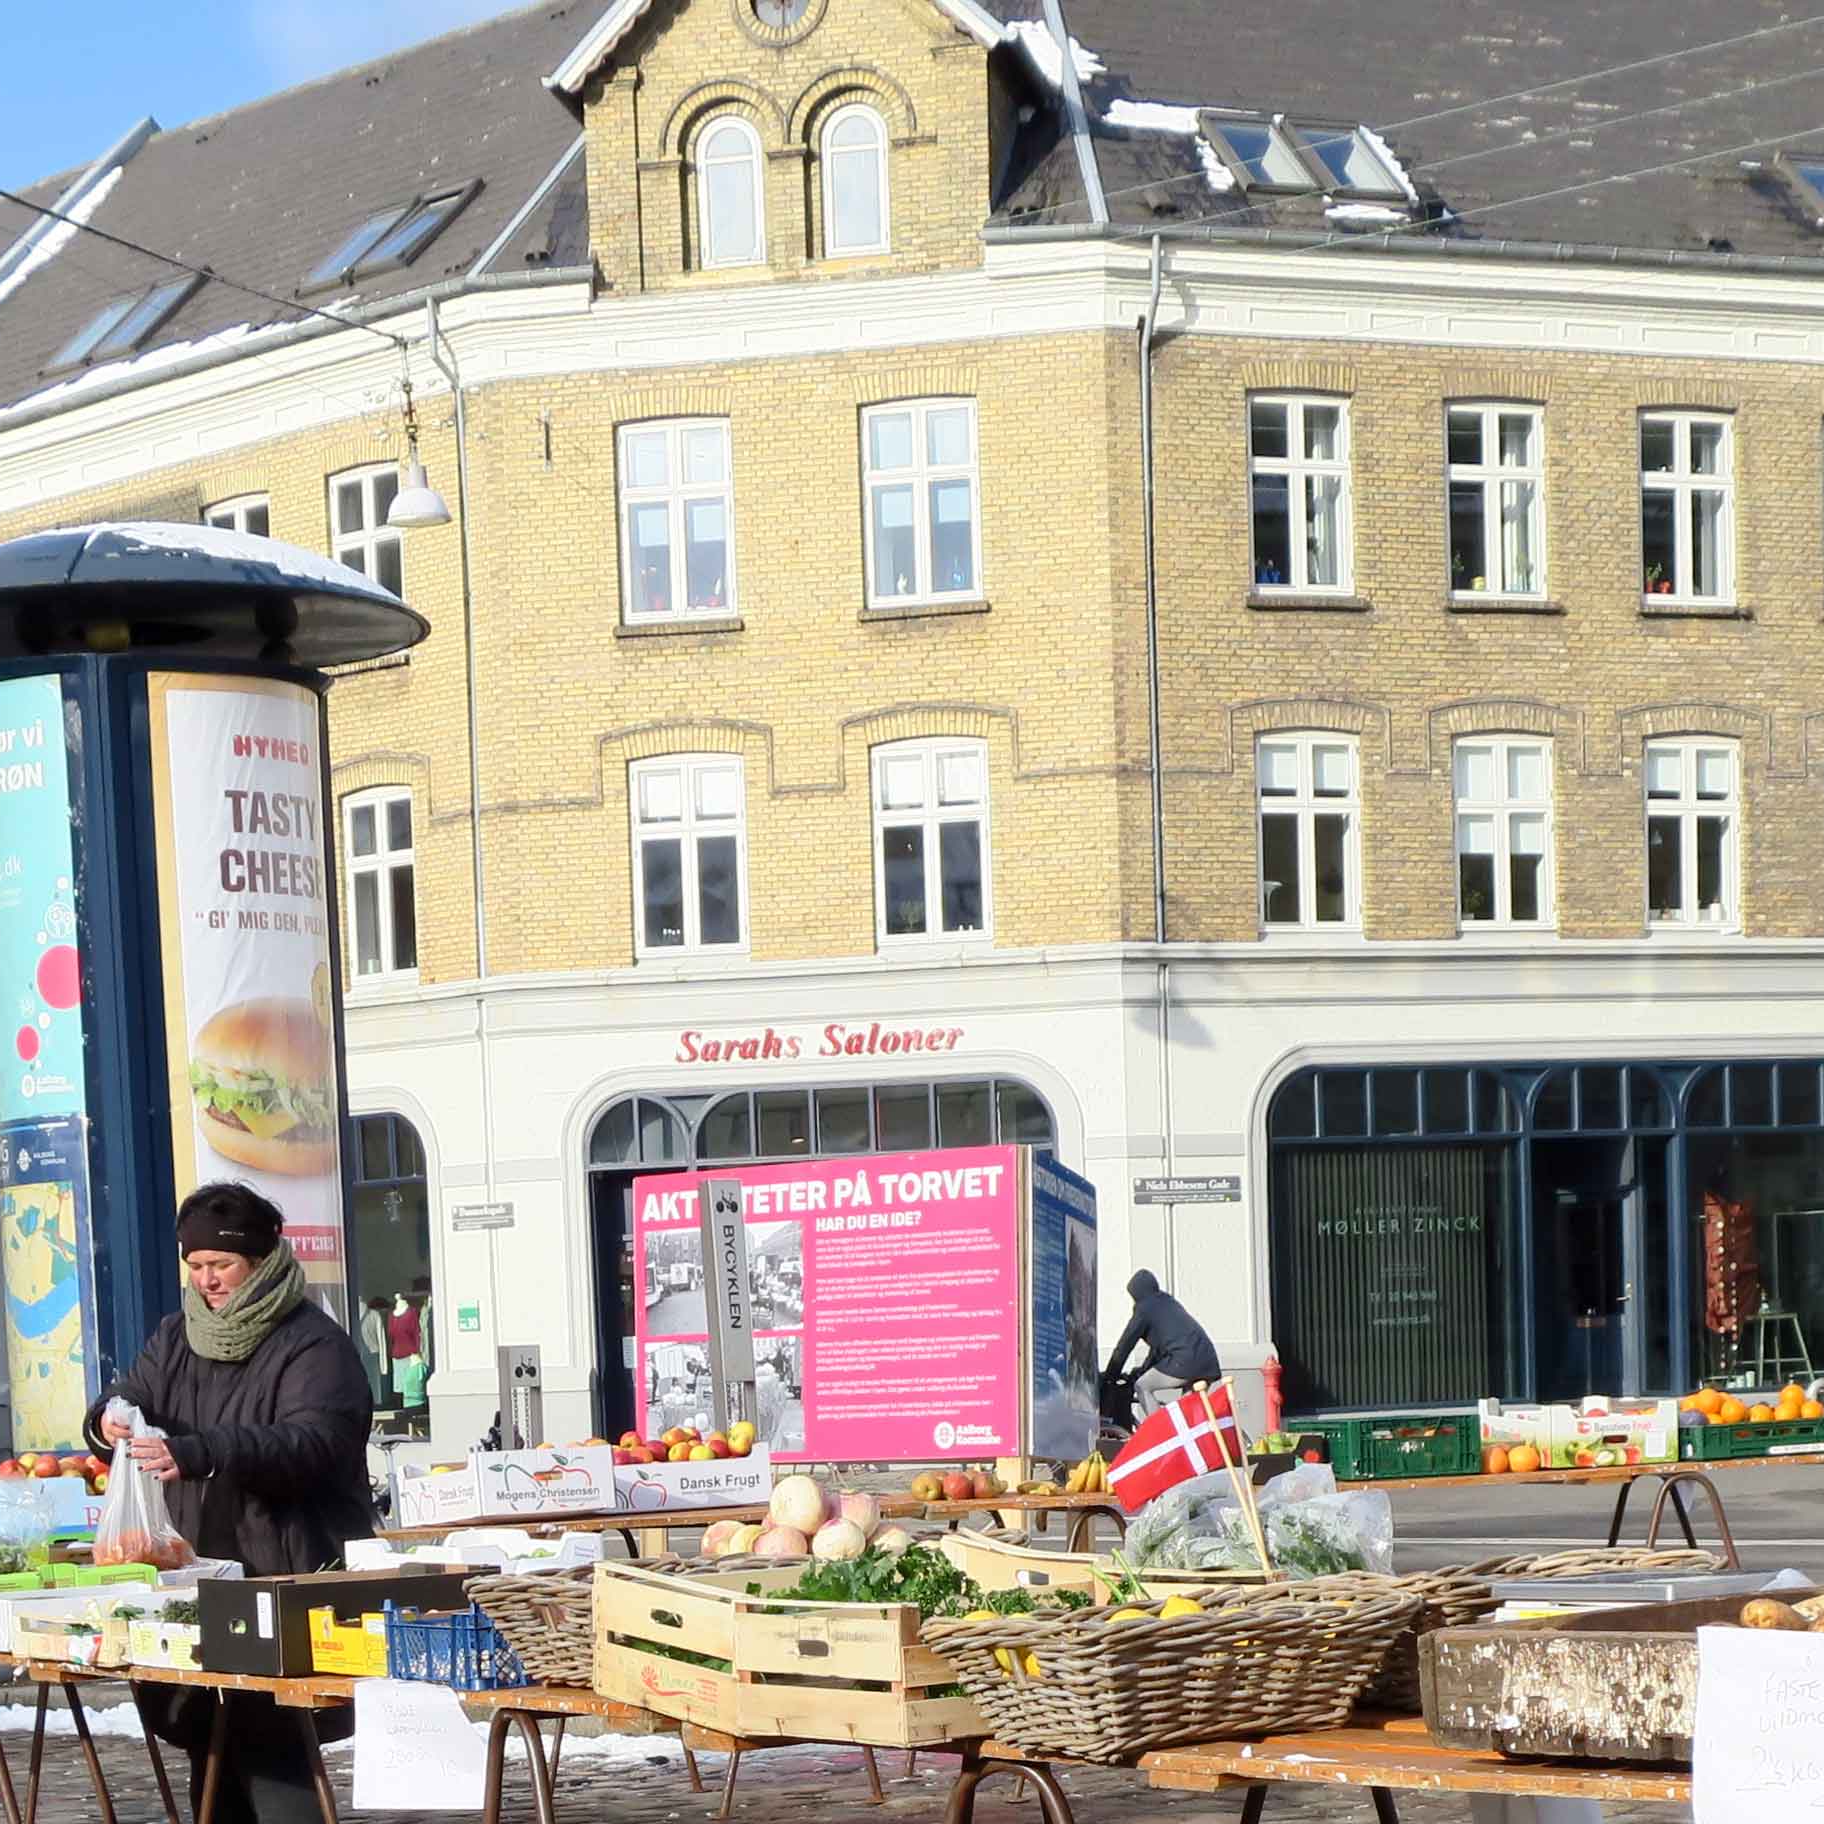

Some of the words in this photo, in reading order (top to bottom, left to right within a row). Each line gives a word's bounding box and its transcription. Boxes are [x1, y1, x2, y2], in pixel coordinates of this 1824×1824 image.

[22, 719, 44, 747] vi
[224, 789, 316, 841] TASTY
[238, 911, 269, 931] MIG
[675, 1028, 803, 1063] Sarahs
[819, 1022, 964, 1057] Saloner
[833, 1169, 872, 1208] PÅ
[878, 1165, 1004, 1203] TORVET
[815, 1217, 845, 1233] HAR
[847, 1215, 867, 1230] DU
[869, 1213, 888, 1228] EN
[891, 1211, 923, 1226] IDE?
[1318, 1218, 1401, 1236] MØLLER
[1413, 1216, 1481, 1233] ZINCK
[723, 1224, 743, 1329] BYCYKLEN
[957, 1424, 992, 1436] Aalborg
[957, 1435, 1001, 1445] Kommune
[679, 1475, 721, 1490] Dansk
[725, 1473, 761, 1489] Frugt
[496, 1490, 537, 1502] Mogens
[539, 1486, 600, 1500] Christensen
